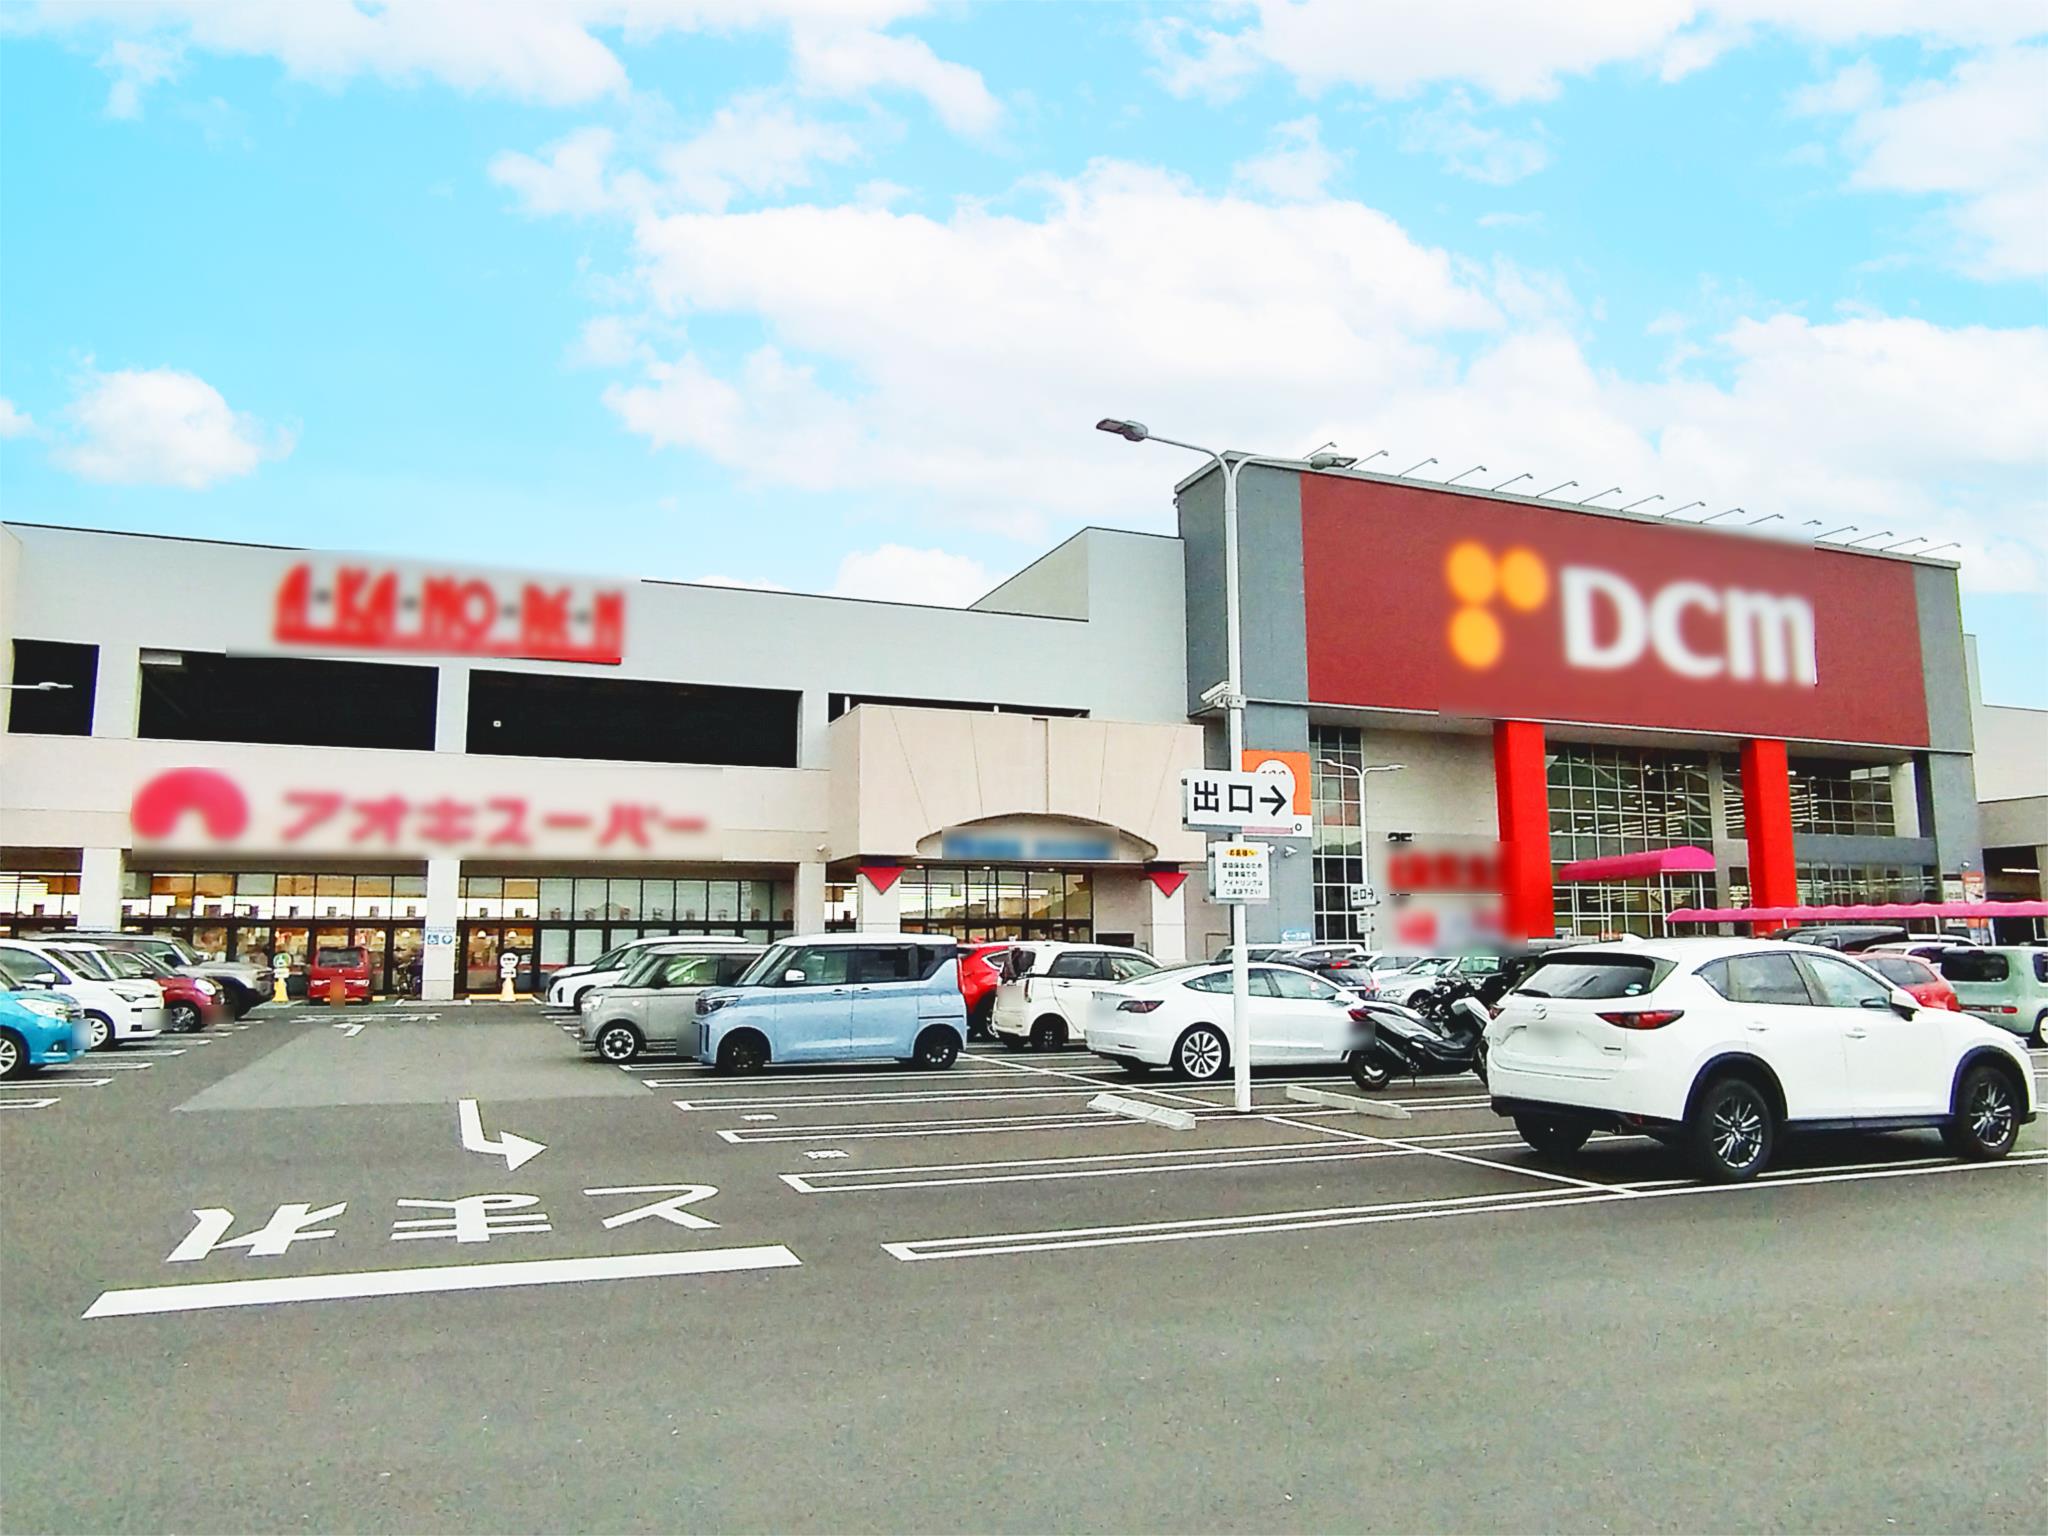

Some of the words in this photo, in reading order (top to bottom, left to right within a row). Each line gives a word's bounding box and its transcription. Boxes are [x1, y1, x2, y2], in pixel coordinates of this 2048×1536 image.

[1193, 780, 1253, 814] 出口
[166, 1183, 721, 1262] とまれ
